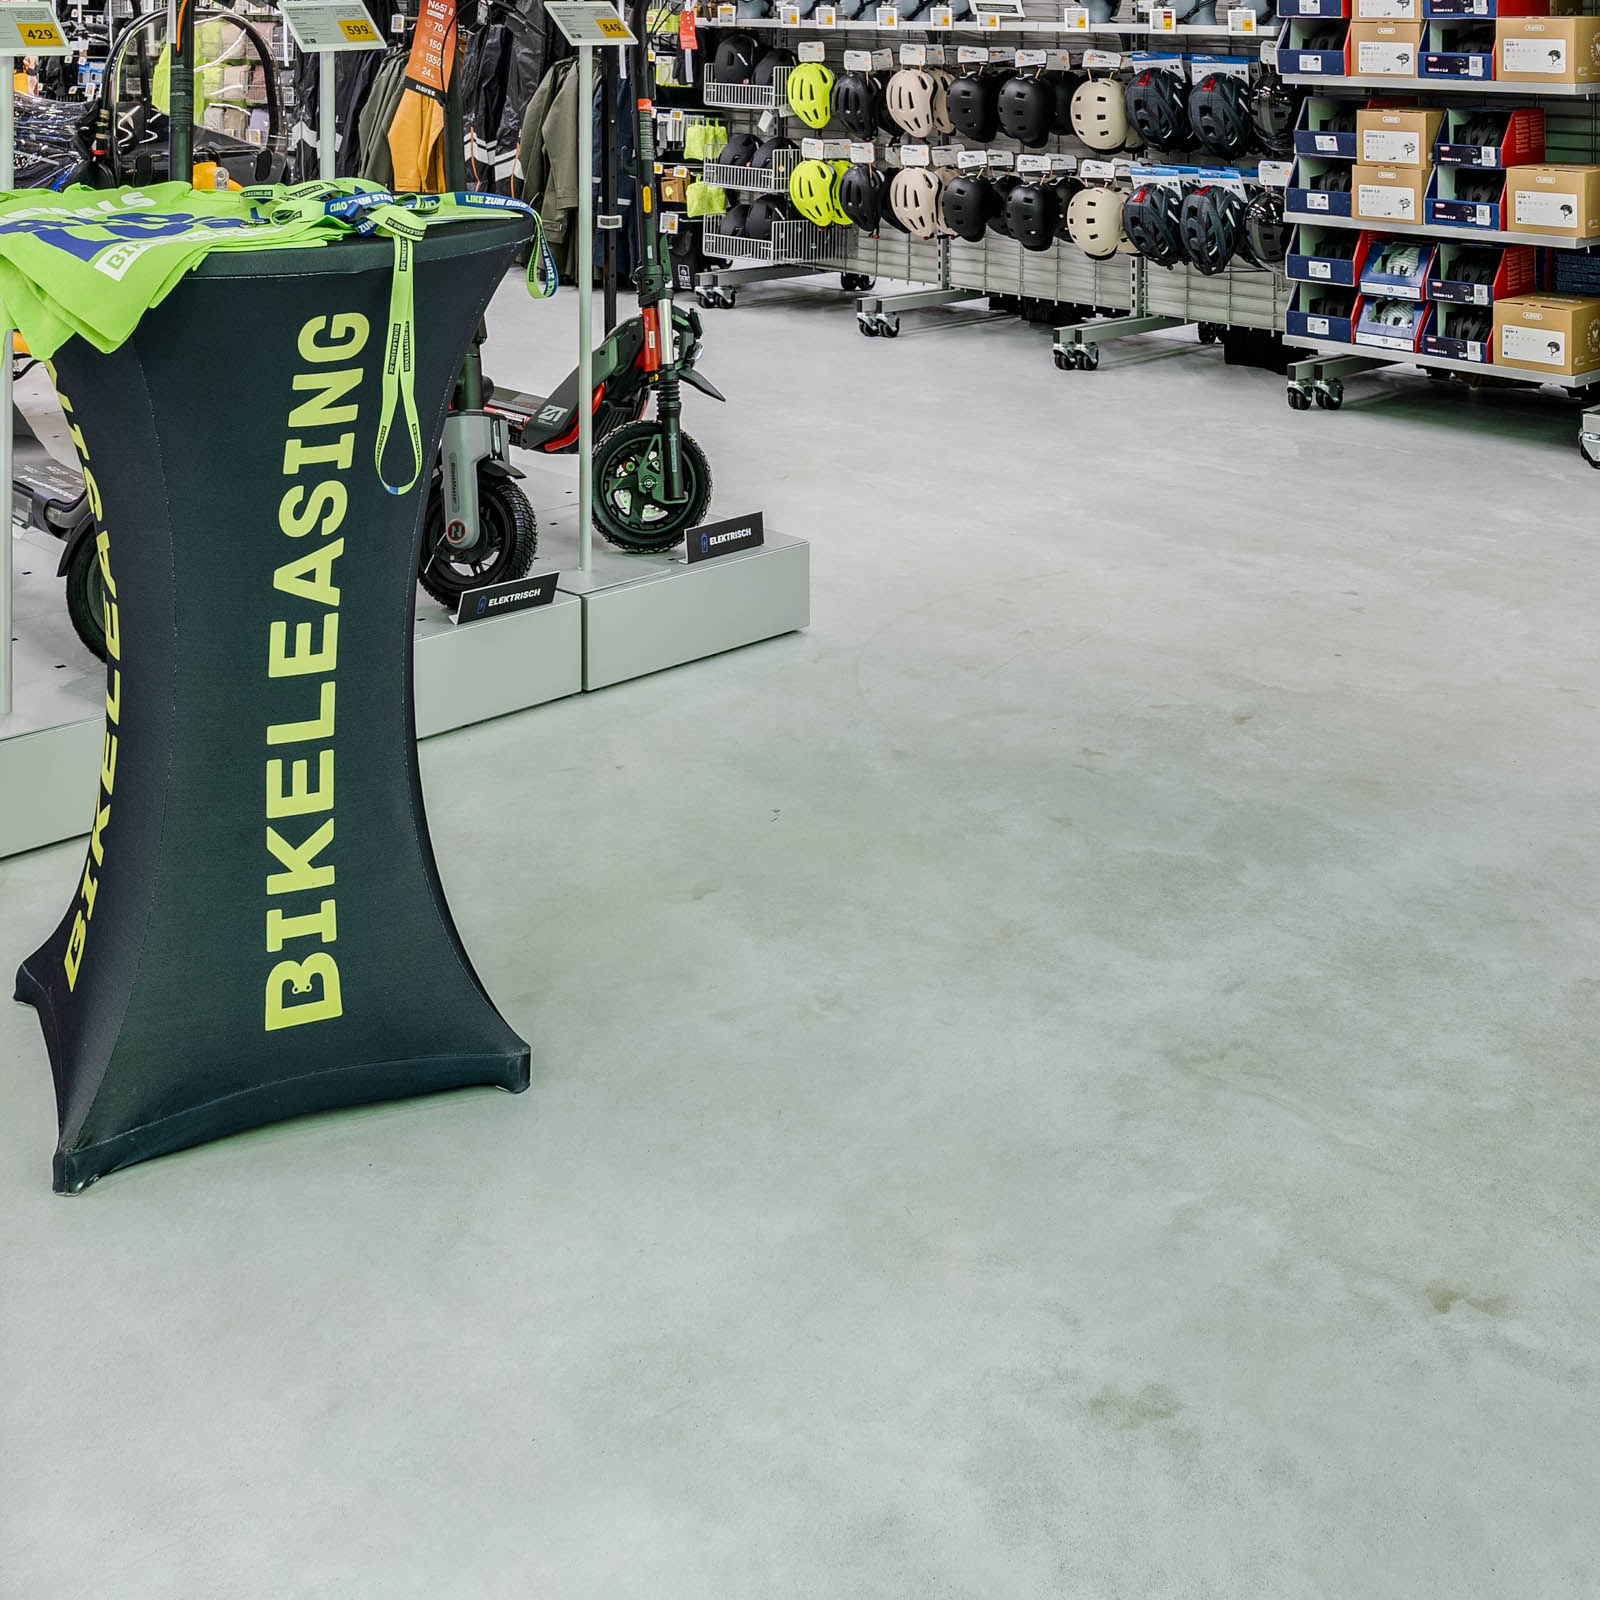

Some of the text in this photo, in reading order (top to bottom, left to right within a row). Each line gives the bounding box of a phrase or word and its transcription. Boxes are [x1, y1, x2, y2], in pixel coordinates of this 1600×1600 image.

[28, 30, 54, 40] 429
[346, 25, 369, 36] 599
[466, 194, 484, 204] LIKE
[484, 196, 506, 206] ZUM
[709, 528, 752, 547] ELEKTRISCH
[488, 588, 542, 608] ELEKTRISCH
[263, 310, 370, 1032] BIKELEASING
